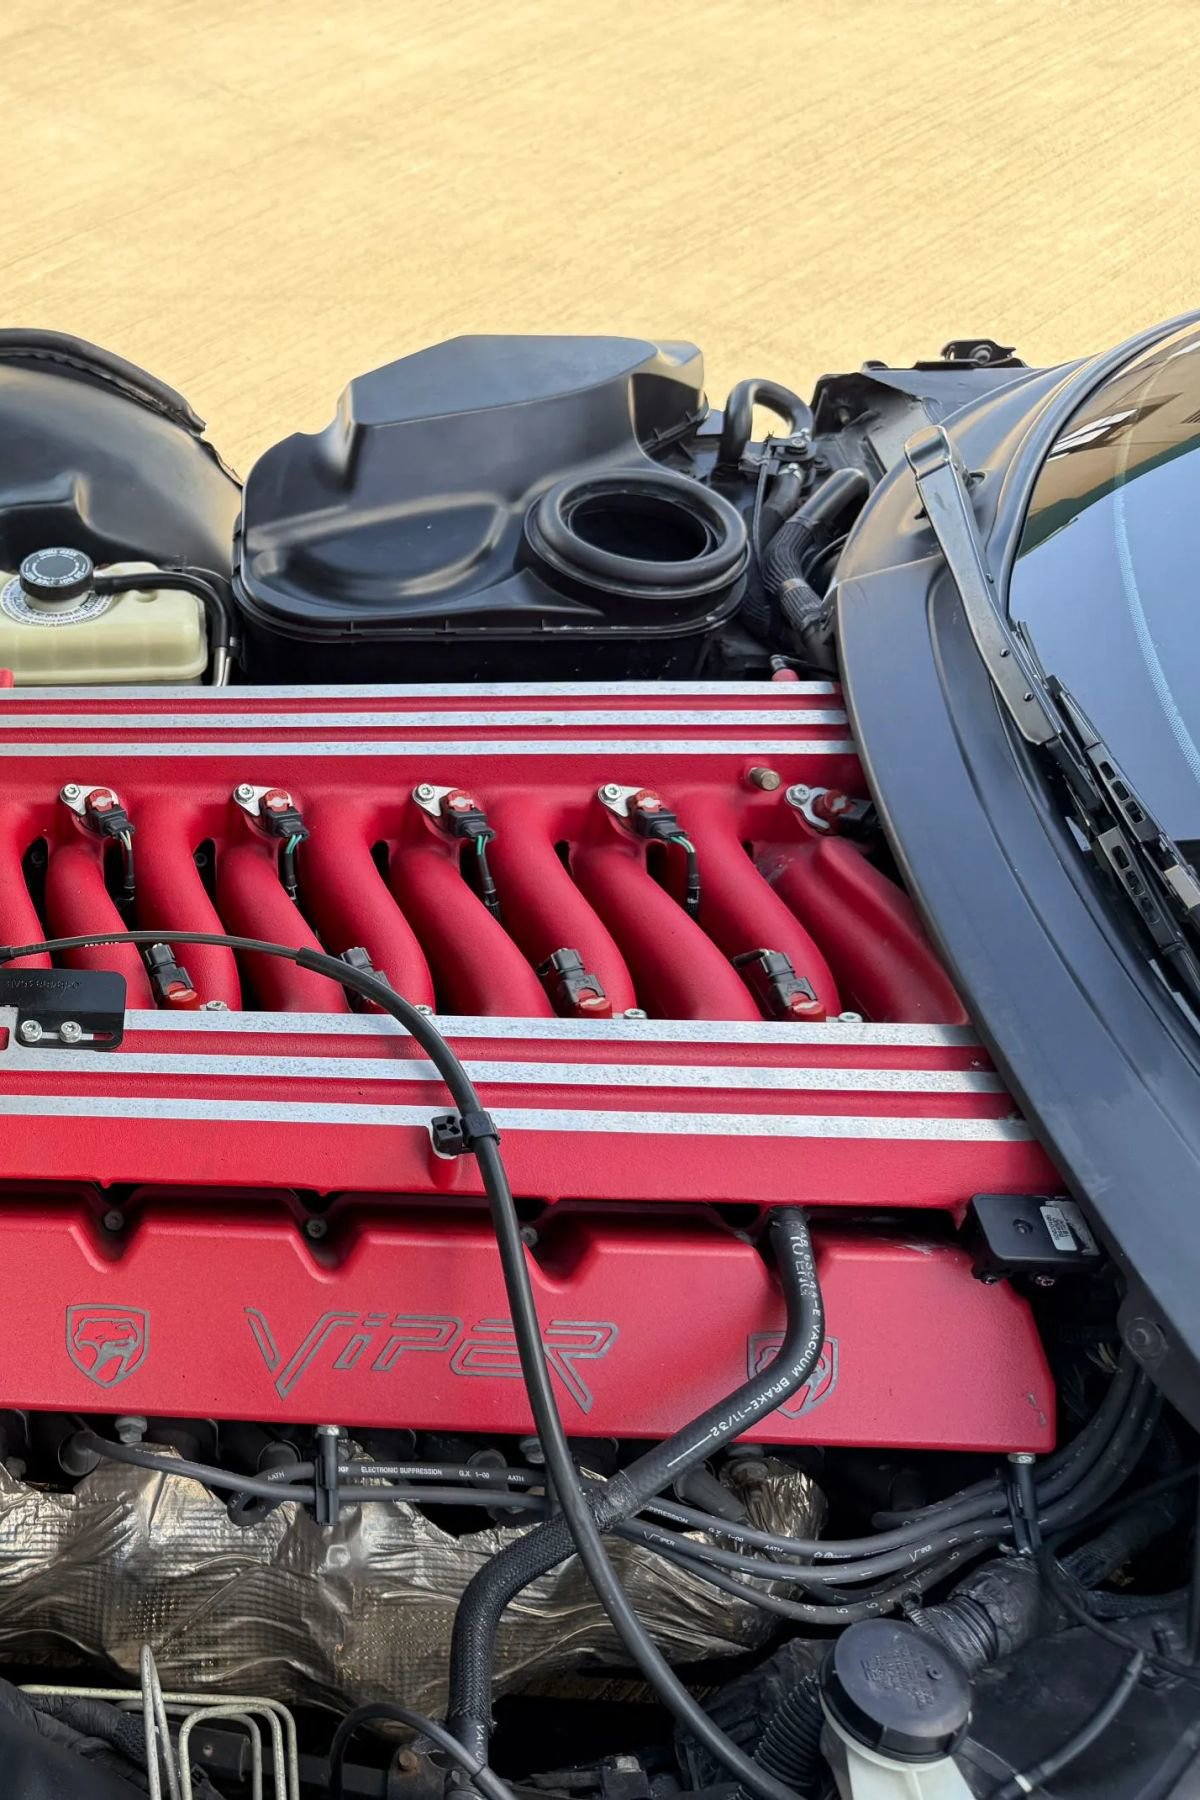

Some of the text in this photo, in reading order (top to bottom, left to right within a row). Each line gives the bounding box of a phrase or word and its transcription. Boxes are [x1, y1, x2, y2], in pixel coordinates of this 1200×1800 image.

[792, 1324, 821, 1377] VACUUM
[361, 1466, 399, 1474] ELECTRONIC
[399, 1467, 443, 1476] SUPPRESSION
